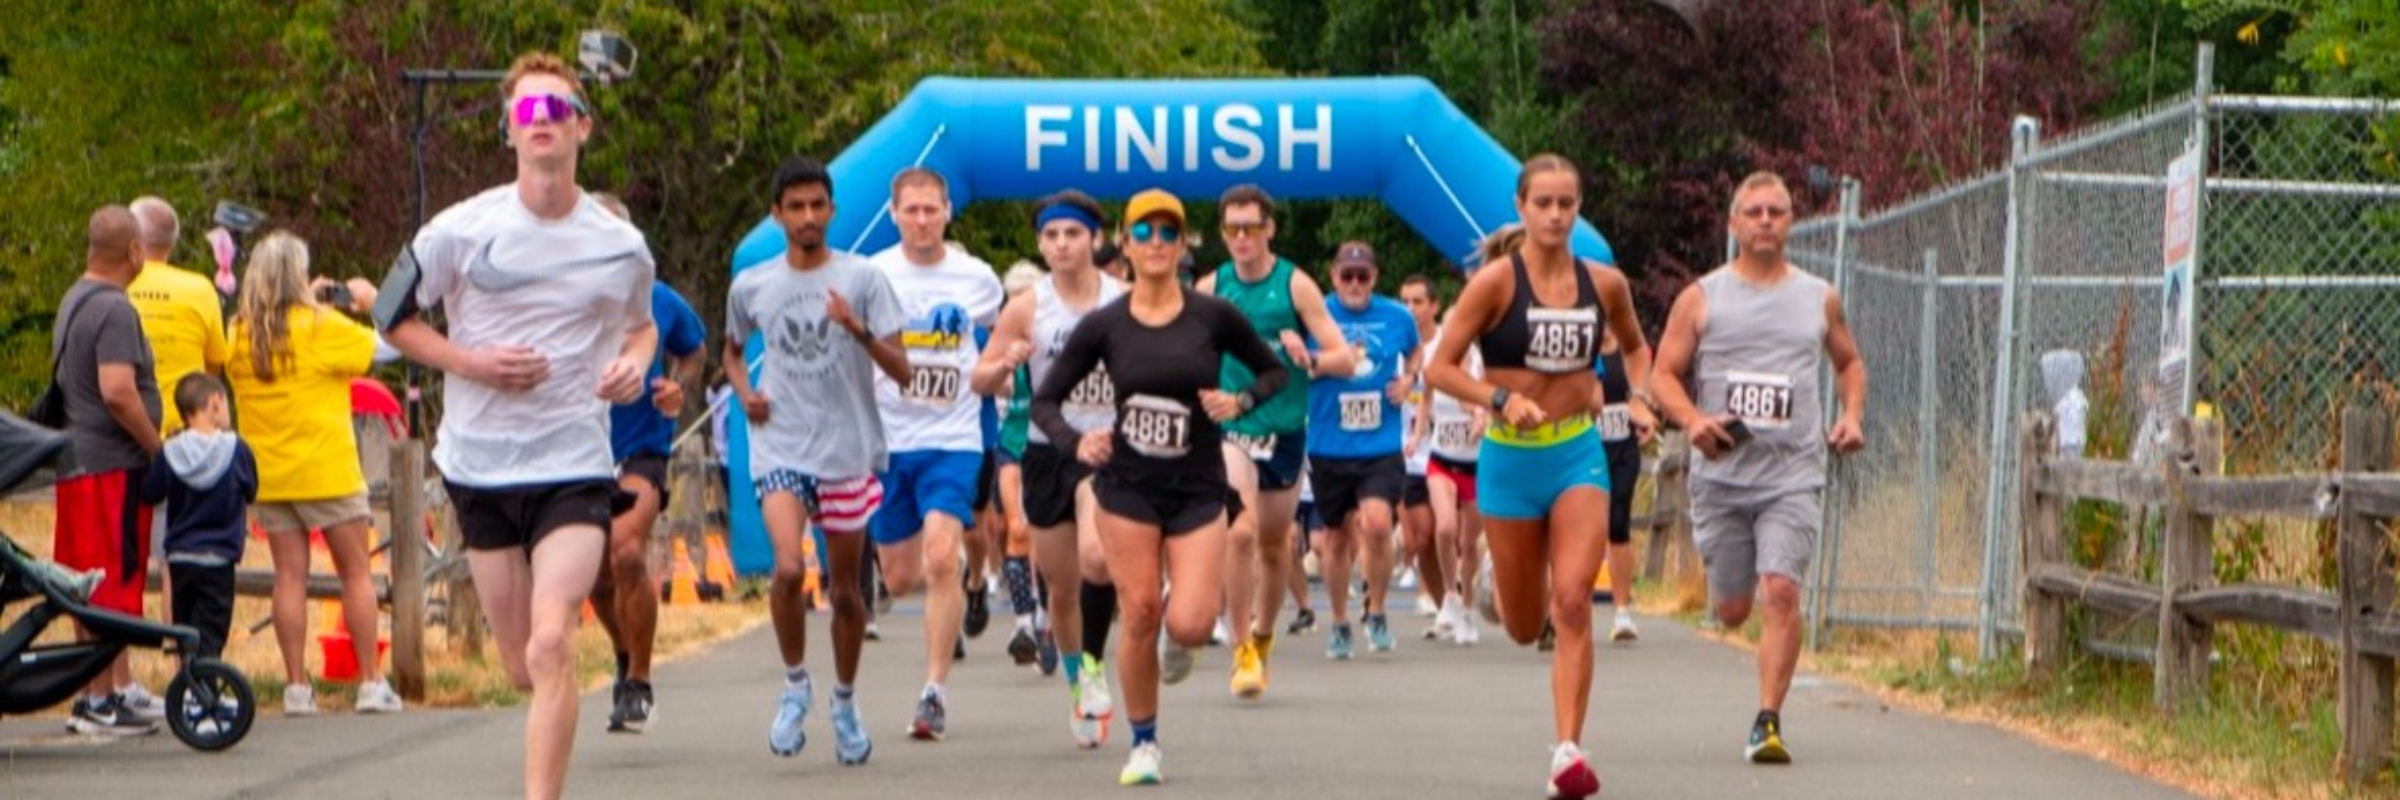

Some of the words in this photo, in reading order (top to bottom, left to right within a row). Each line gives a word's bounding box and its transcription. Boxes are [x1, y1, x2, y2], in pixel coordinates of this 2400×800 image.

[1025, 103, 1333, 172] FINISH
[1530, 322, 1594, 358] 4851
[1729, 384, 1790, 418] 4861
[1121, 407, 1186, 448] 4881
